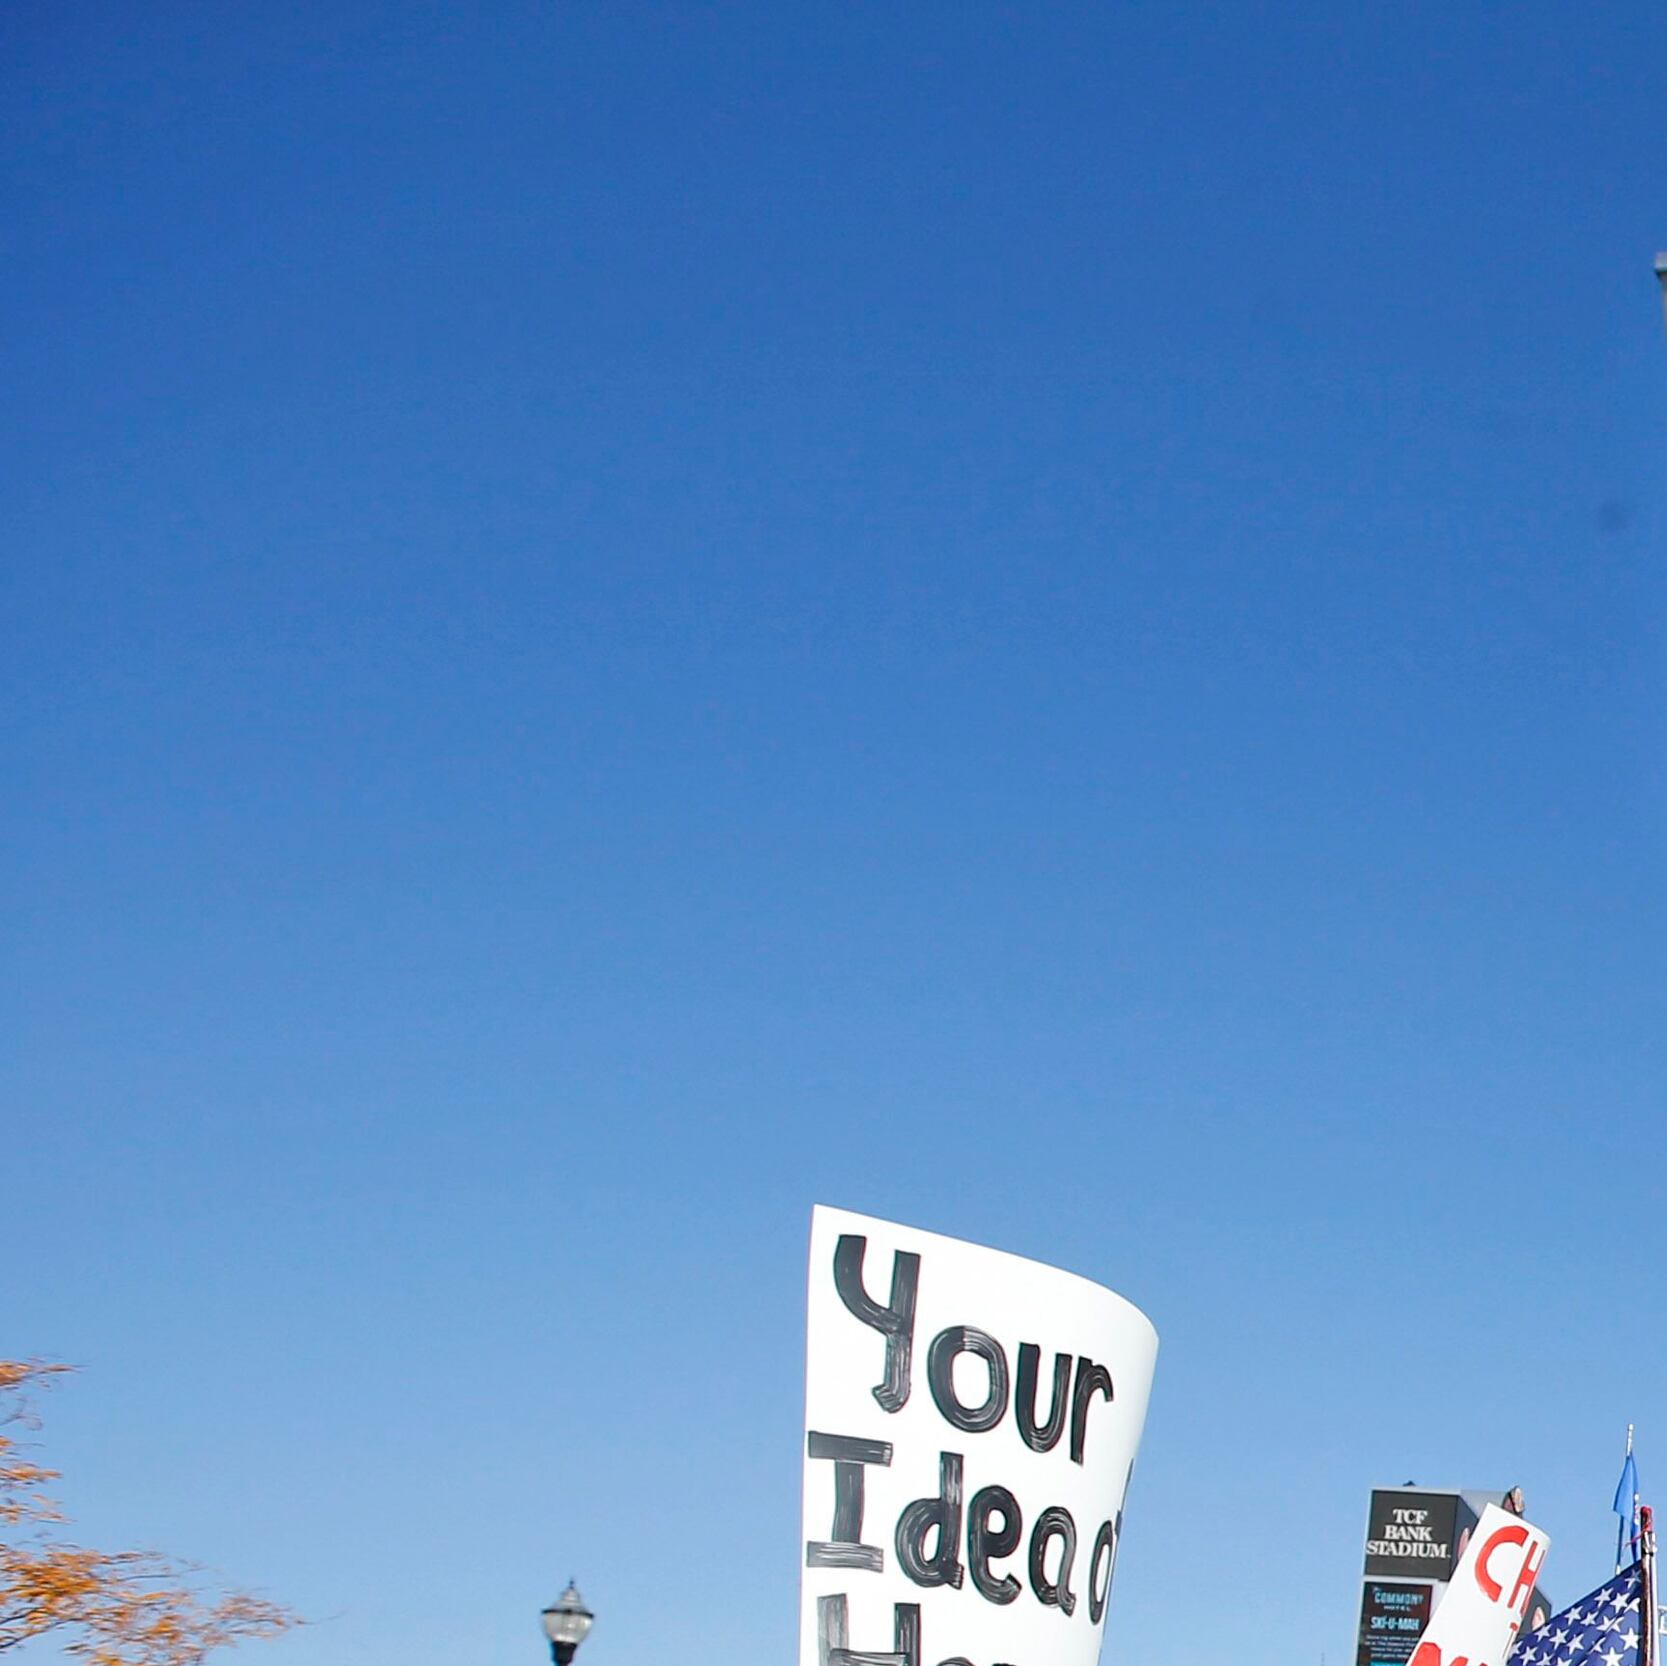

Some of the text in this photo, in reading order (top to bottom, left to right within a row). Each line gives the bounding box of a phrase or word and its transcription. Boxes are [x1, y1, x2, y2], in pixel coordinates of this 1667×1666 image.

[834, 1233, 1114, 1465] Your
[806, 1430, 1077, 1616] Idea
[1383, 1525, 1432, 1541] BANK
[1392, 1508, 1428, 1525] TCF
